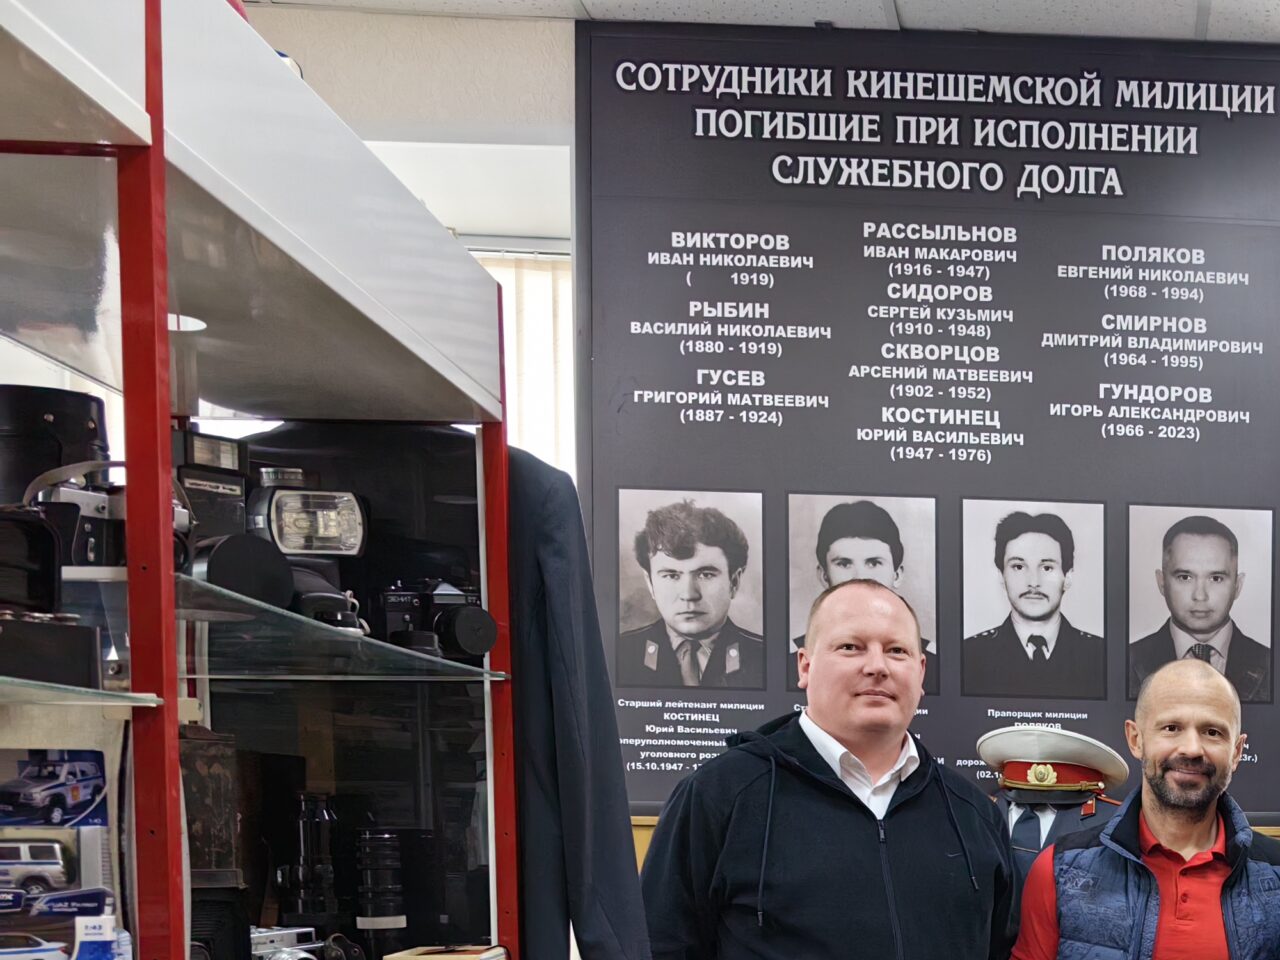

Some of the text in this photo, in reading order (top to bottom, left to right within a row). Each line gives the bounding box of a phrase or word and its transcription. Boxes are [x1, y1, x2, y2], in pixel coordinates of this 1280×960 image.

[614, 61, 1277, 119] СОТРУДНИКИ КИНЕШЕМСКОЙ МИЛИЦИИ
[694, 108, 1199, 156] ПОГИБШИЕ ПРИ ИСПОЛНЕНИИ
[771, 154, 1125, 199] СЛУЖЕБНОГО ДОЛГА
[671, 231, 790, 251] ВИКТОРОВ
[863, 222, 1018, 243] РАССЫЛЬНОВ
[647, 252, 814, 269] ИВАН НИКОЛАЕВИЧ
[863, 245, 1017, 263] ИВАН МАКАРОВИЧ
[1101, 244, 1206, 265] ПОЛЯКОВ
[730, 272, 775, 288] 1919)
[888, 263, 933, 278] (1916
[946, 264, 991, 282] 1947)
[1057, 264, 1249, 285] ЕВГЕНИЙ НИКОЛАЕВИЧ
[886, 282, 993, 304] СИДОРОВ
[1104, 284, 1148, 300] (1968
[1161, 286, 1204, 304] 1994)
[689, 300, 770, 319] РЫБИН
[867, 304, 1014, 323] СЕРГЕЙ КУЗЬМИЧ
[630, 320, 832, 339] ВАСИЛИЙ НИКОЛАЕВИЧ
[889, 322, 934, 338] (1910
[947, 324, 992, 341] 1948)
[1101, 313, 1207, 334] СМИРНОВ
[679, 339, 725, 356] (1880
[738, 341, 783, 358] 1919)
[1040, 332, 1264, 354] ДМИТРИЙ ВЛАДИМИРОВИЧ
[880, 342, 1001, 365] СКВОРЦОВ
[1103, 352, 1148, 368] (1964
[1161, 354, 1204, 372] 1995)
[696, 368, 766, 387] ГУСЕВ
[848, 364, 1033, 384] АРСЕНИЙ МАТВЕЕВИЧ
[633, 389, 829, 409] ГРИГОРИЙ МАТВЕЕВИЧ
[889, 384, 934, 400] (1902
[948, 385, 992, 403] 1952)
[1099, 383, 1213, 404] ГУНДОРОВ
[679, 408, 725, 424] (1887
[739, 410, 783, 427] 1924)
[881, 406, 1001, 430] КОСТИНЕЦ
[1049, 403, 1250, 424] ИГОРЬ АЛЕКСАНДРОВИЧ
[856, 426, 1024, 446] ЮРИЙ ВАСИЛЬЕВИЧ
[1101, 423, 1145, 439] (1966
[1157, 425, 1201, 443] 2023)
[890, 445, 935, 462] (1947
[948, 447, 992, 465] 1976)
[618, 698, 765, 712] Старший лейтенант милиции
[987, 709, 1088, 721] Прапорщик милиции
[663, 712, 720, 723] КОСТИНЕЦ
[645, 724, 738, 736] Юрий Васильевич
[640, 751, 698, 761] уголовного
[626, 761, 683, 773] (15.10.1947
